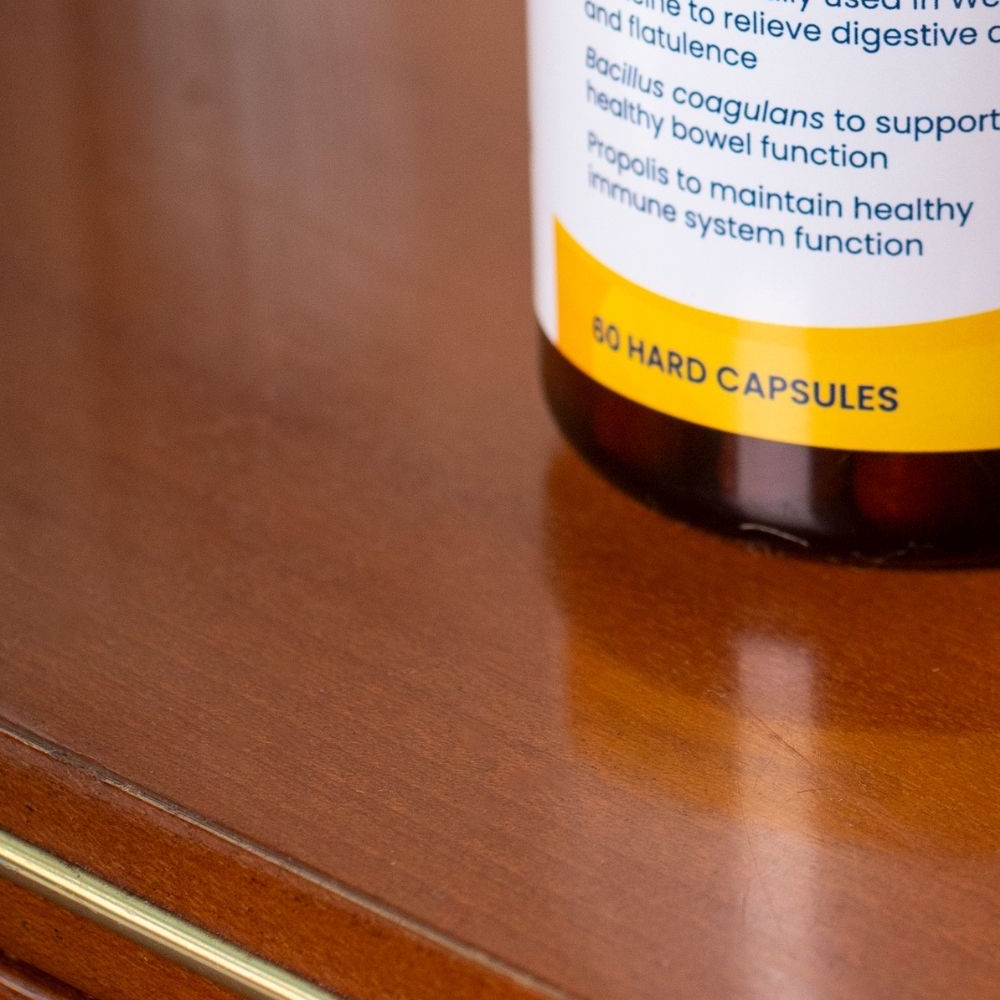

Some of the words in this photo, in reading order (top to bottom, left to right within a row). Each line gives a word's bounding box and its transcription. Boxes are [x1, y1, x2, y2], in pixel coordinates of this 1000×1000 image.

[628, 13, 758, 70] flatulence
[687, 0, 716, 26] to
[723, 10, 822, 43] relieve
[830, 20, 979, 55] digestive
[585, 46, 665, 99] Bacillus
[671, 85, 825, 130] coagulans
[833, 108, 866, 134] to
[875, 108, 1000, 143] support
[586, 79, 665, 140] healthy
[671, 115, 752, 156] bowel
[760, 134, 889, 170] function
[587, 129, 669, 186] Propolis
[676, 168, 702, 195] to
[709, 181, 844, 219] maintain
[853, 195, 975, 228] healthy
[588, 163, 678, 223] immune
[684, 210, 786, 247] system
[794, 225, 924, 257] function
[592, 315, 621, 352] 60
[627, 334, 708, 385] HARD
[716, 366, 900, 413] CAPSULES
